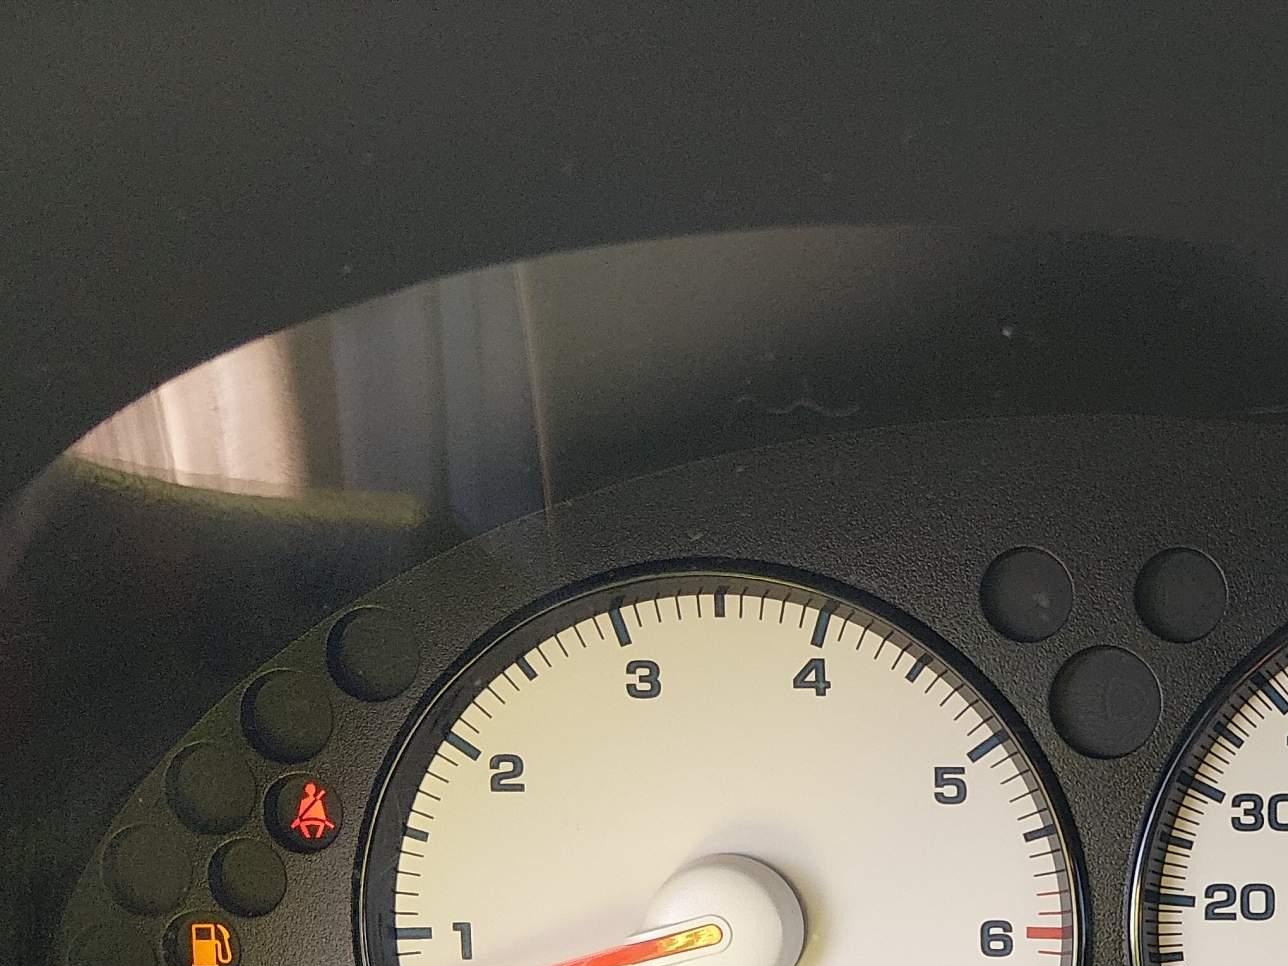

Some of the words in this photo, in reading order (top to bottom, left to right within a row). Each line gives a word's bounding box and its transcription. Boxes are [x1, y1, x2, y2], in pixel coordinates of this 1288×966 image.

[626, 660, 661, 699] 3
[793, 658, 831, 696] 4
[490, 754, 525, 792] 2
[934, 767, 967, 804] 5
[1205, 884, 1275, 920] 20
[453, 922, 472, 960] 1
[980, 920, 1013, 957] 6
